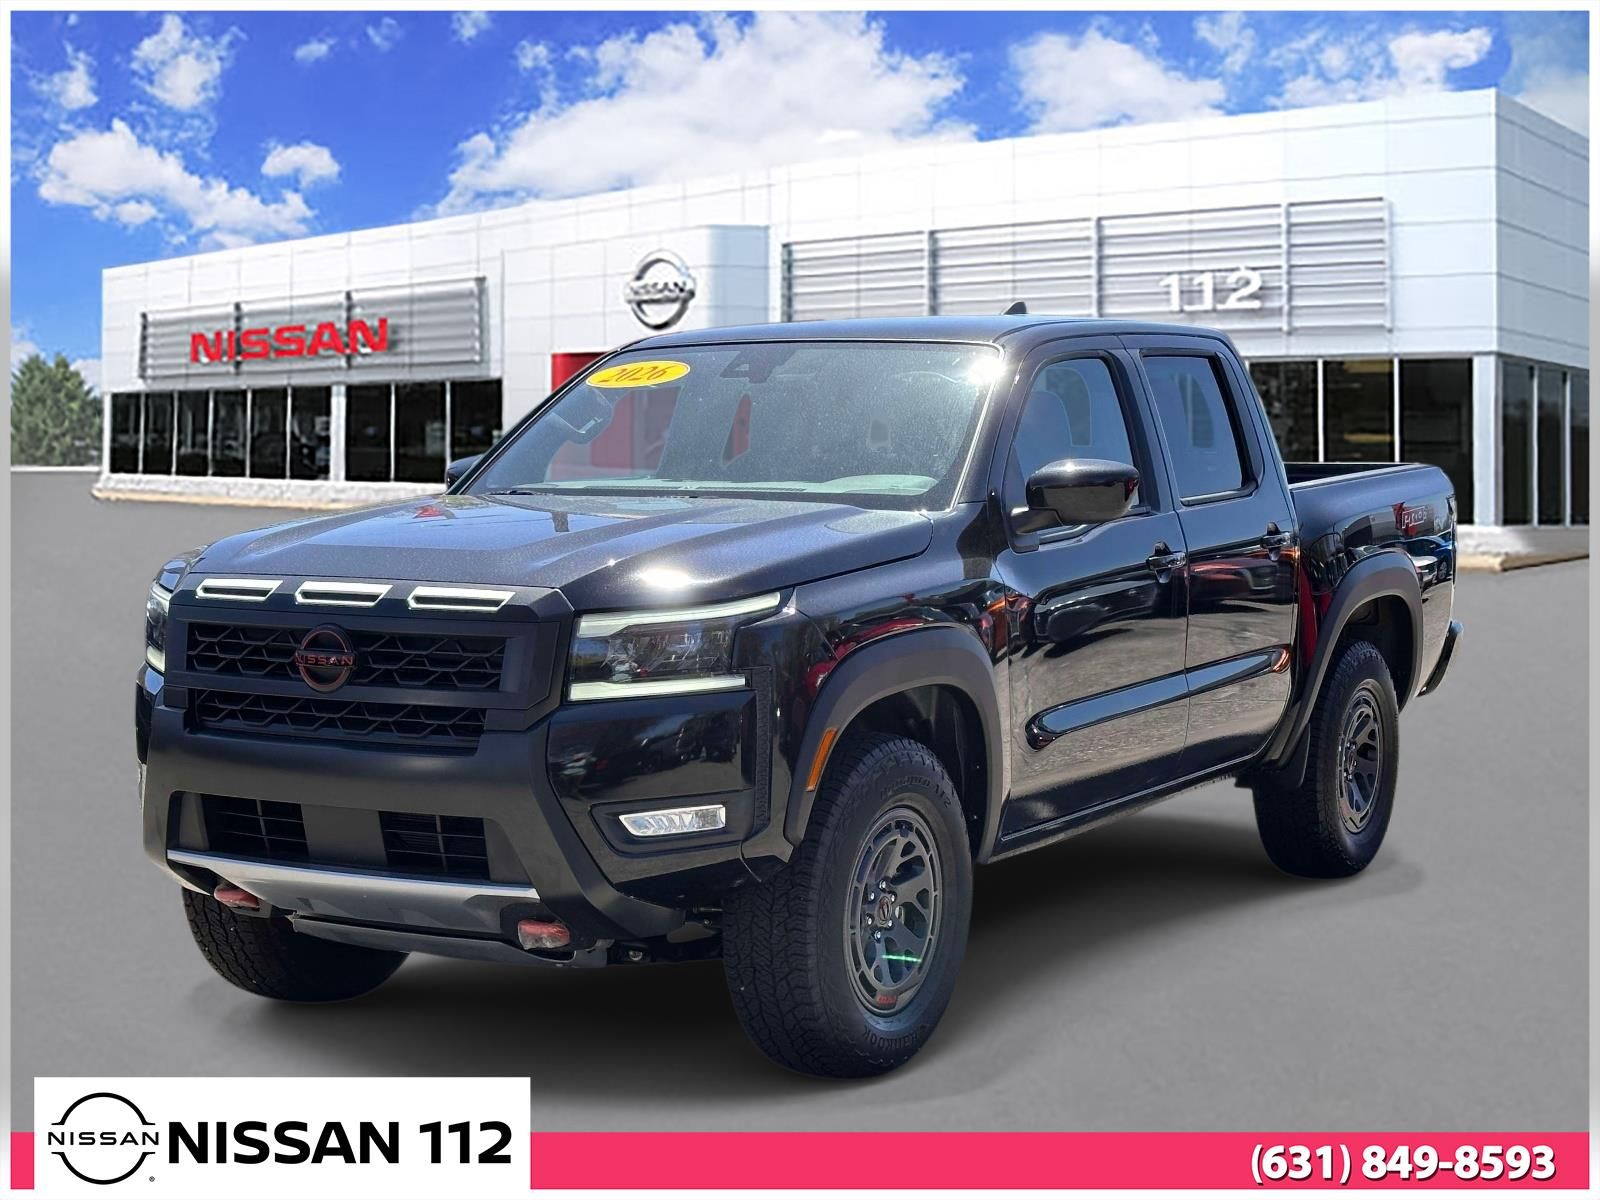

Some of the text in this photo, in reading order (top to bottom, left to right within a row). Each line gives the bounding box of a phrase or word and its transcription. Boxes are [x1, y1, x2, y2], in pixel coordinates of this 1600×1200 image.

[627, 281, 689, 297] NISSAN
[1159, 266, 1262, 312] 112
[190, 317, 389, 364] NISSAN
[597, 365, 677, 383] 2026
[295, 654, 353, 666] NISSAN
